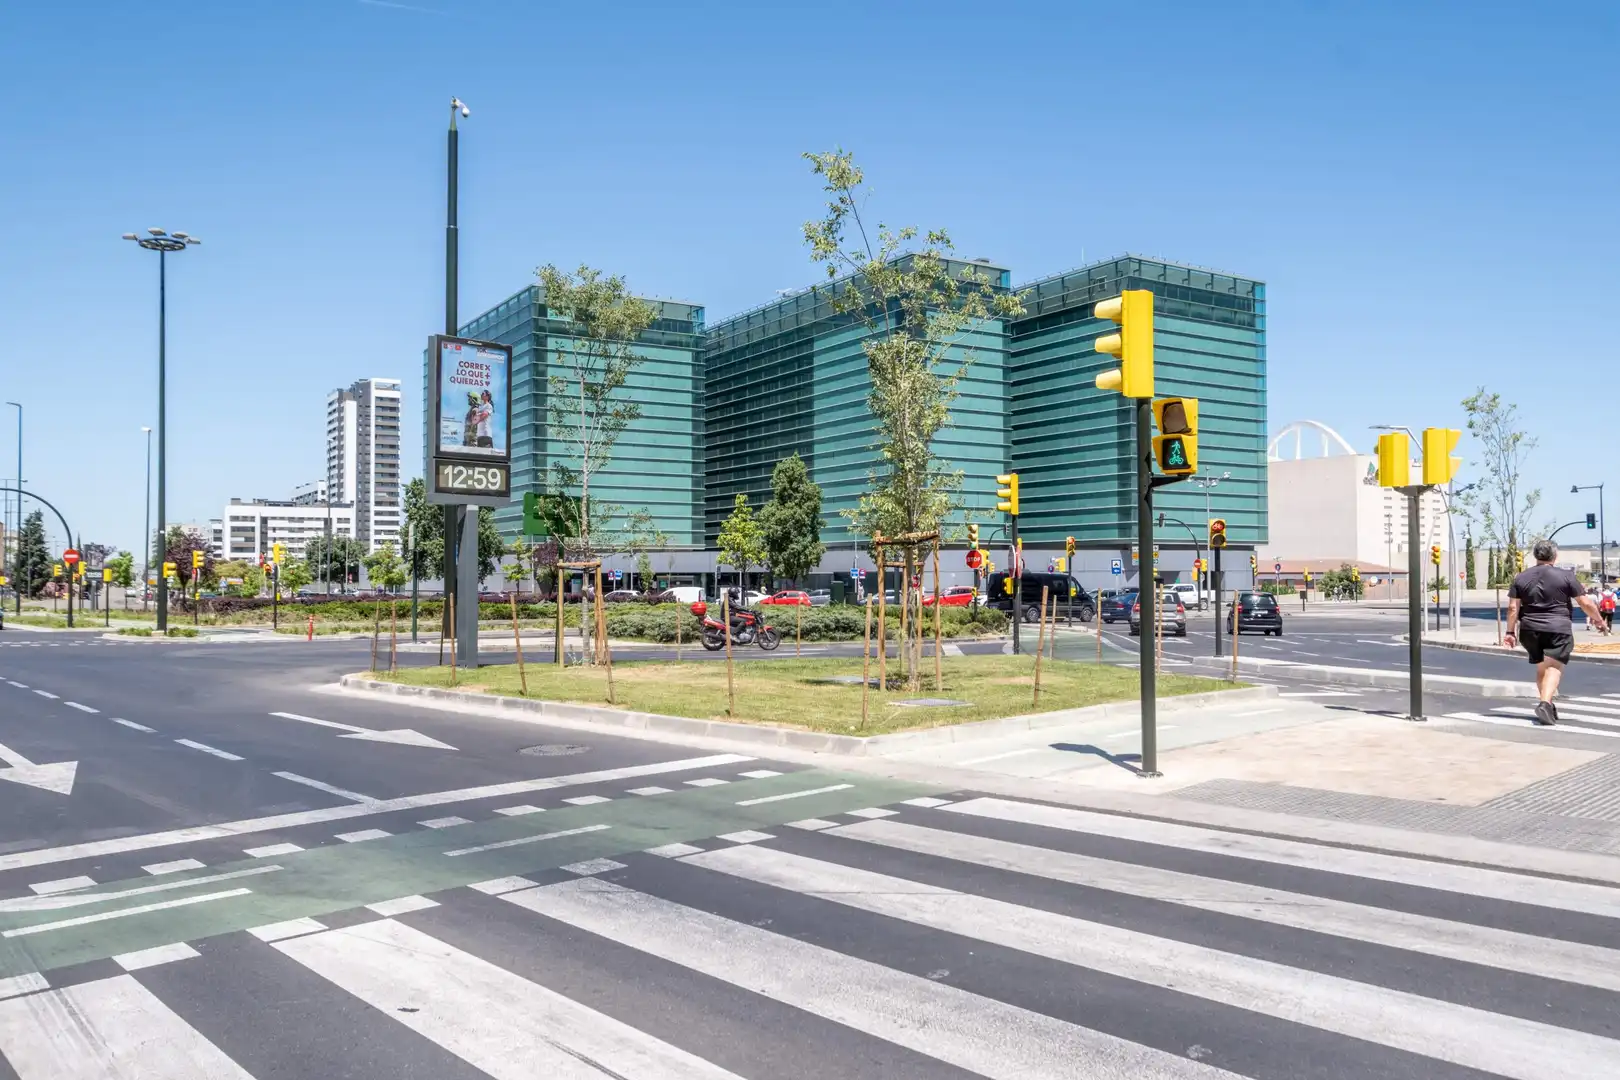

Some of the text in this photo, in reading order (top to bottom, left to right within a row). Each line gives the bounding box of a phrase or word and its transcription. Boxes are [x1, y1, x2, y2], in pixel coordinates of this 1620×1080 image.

[458, 361, 484, 370] CORRE
[456, 368, 467, 376] LO
[468, 370, 484, 378] QUE
[449, 376, 484, 386] QUIERAS
[444, 464, 501, 490] 12:59
